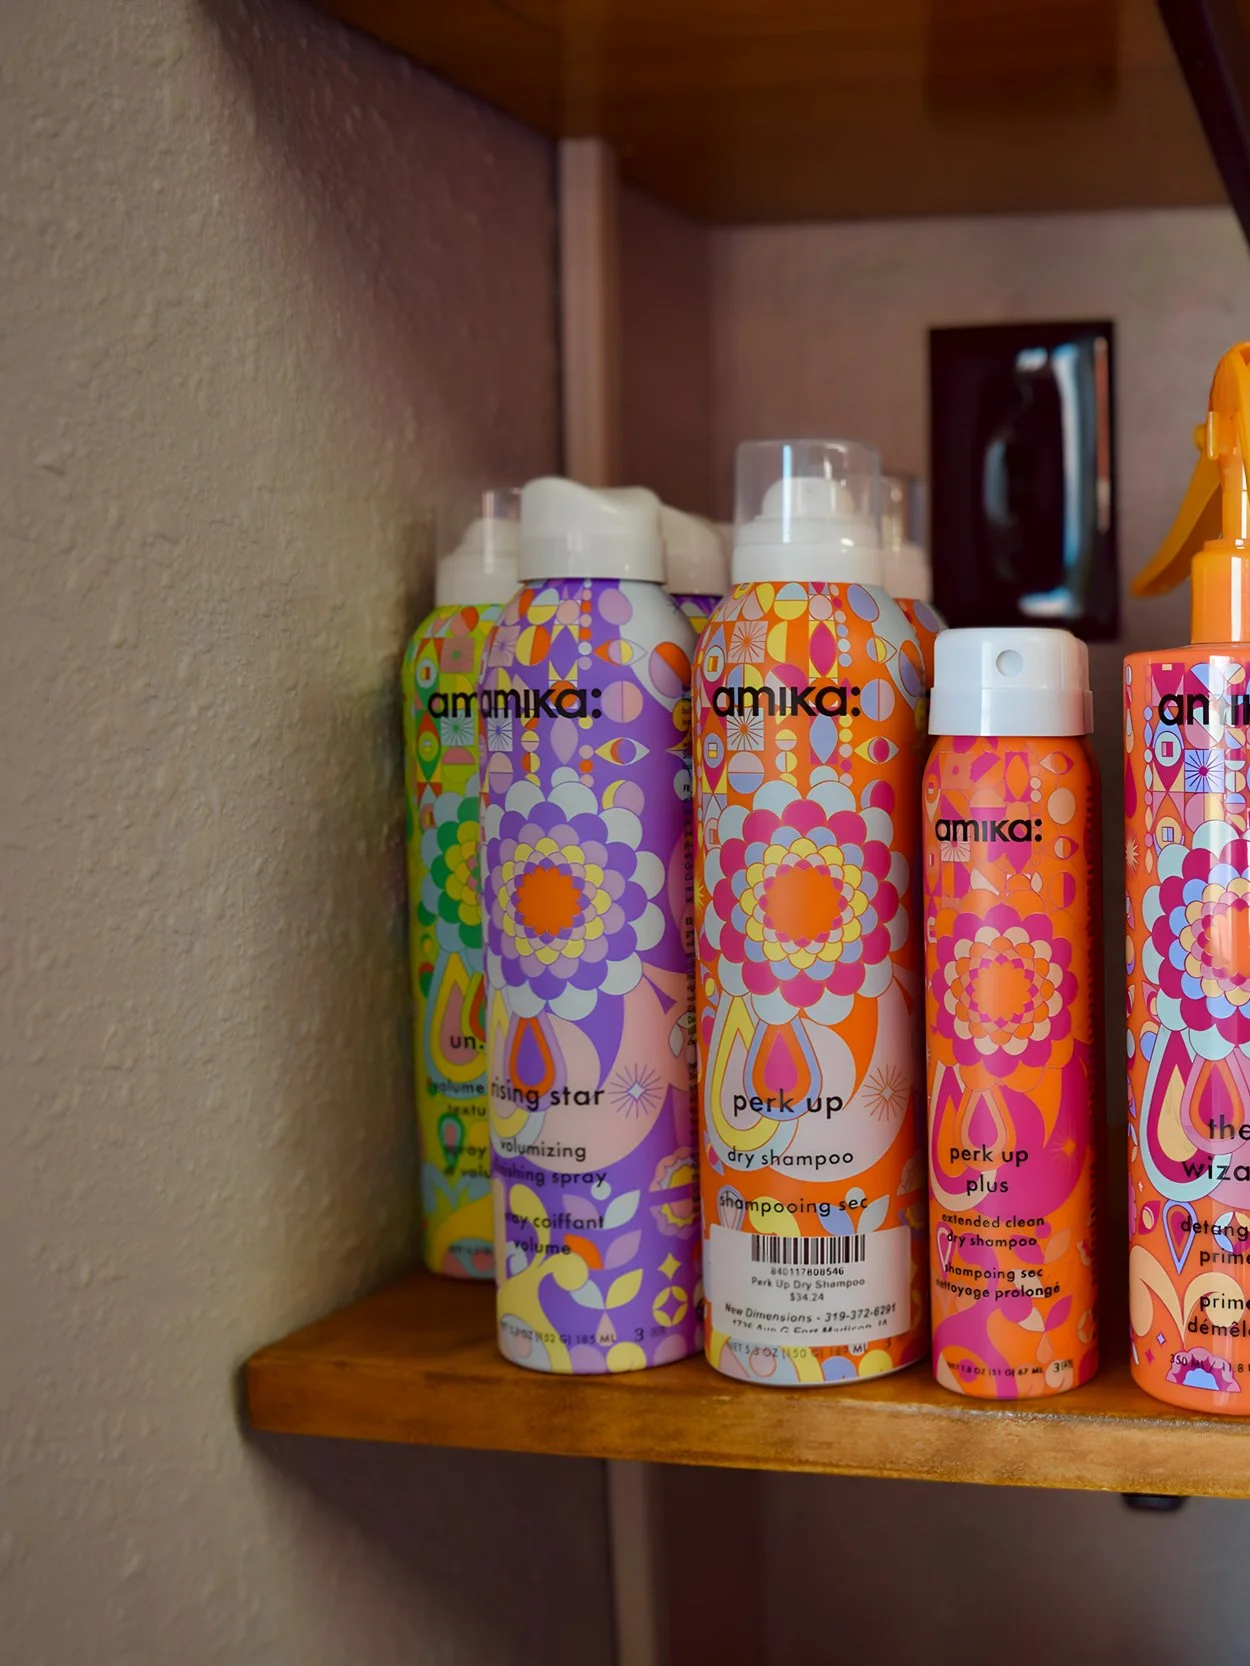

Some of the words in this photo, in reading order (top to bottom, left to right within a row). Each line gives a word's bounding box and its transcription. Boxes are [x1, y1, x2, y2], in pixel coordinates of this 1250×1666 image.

[713, 686, 861, 718] amika:
[935, 818, 1043, 843] amika:
[491, 1077, 540, 1112] rising
[551, 1086, 605, 1106] star
[733, 1088, 795, 1117] perk
[806, 1094, 843, 1120] up
[501, 1138, 586, 1162] volumizing
[728, 1146, 754, 1168] dry
[761, 1149, 853, 1170] shampoo
[950, 1144, 993, 1163] perk
[1002, 1149, 1028, 1167] up
[551, 1171, 607, 1188] spray
[966, 1174, 1009, 1196] plus
[720, 1190, 831, 1217] shampooing
[839, 1197, 868, 1211] sec
[533, 1212, 604, 1230] coiffant
[941, 1213, 1000, 1228] extended
[1005, 1216, 1045, 1228] clean
[515, 1239, 572, 1256] volume
[947, 1231, 966, 1247] dry
[970, 1234, 1037, 1249] shampoo
[752, 1275, 772, 1287] Perk
[776, 1280, 790, 1290] Up
[793, 1280, 811, 1291] Dry
[815, 1277, 865, 1290] Shampoo
[944, 1264, 1015, 1282] shampoing
[1020, 1268, 1043, 1278] sec
[790, 1292, 824, 1302] $34.24
[995, 1282, 1060, 1301] prolongé
[725, 1302, 743, 1316] New
[745, 1307, 812, 1323] Dimensions
